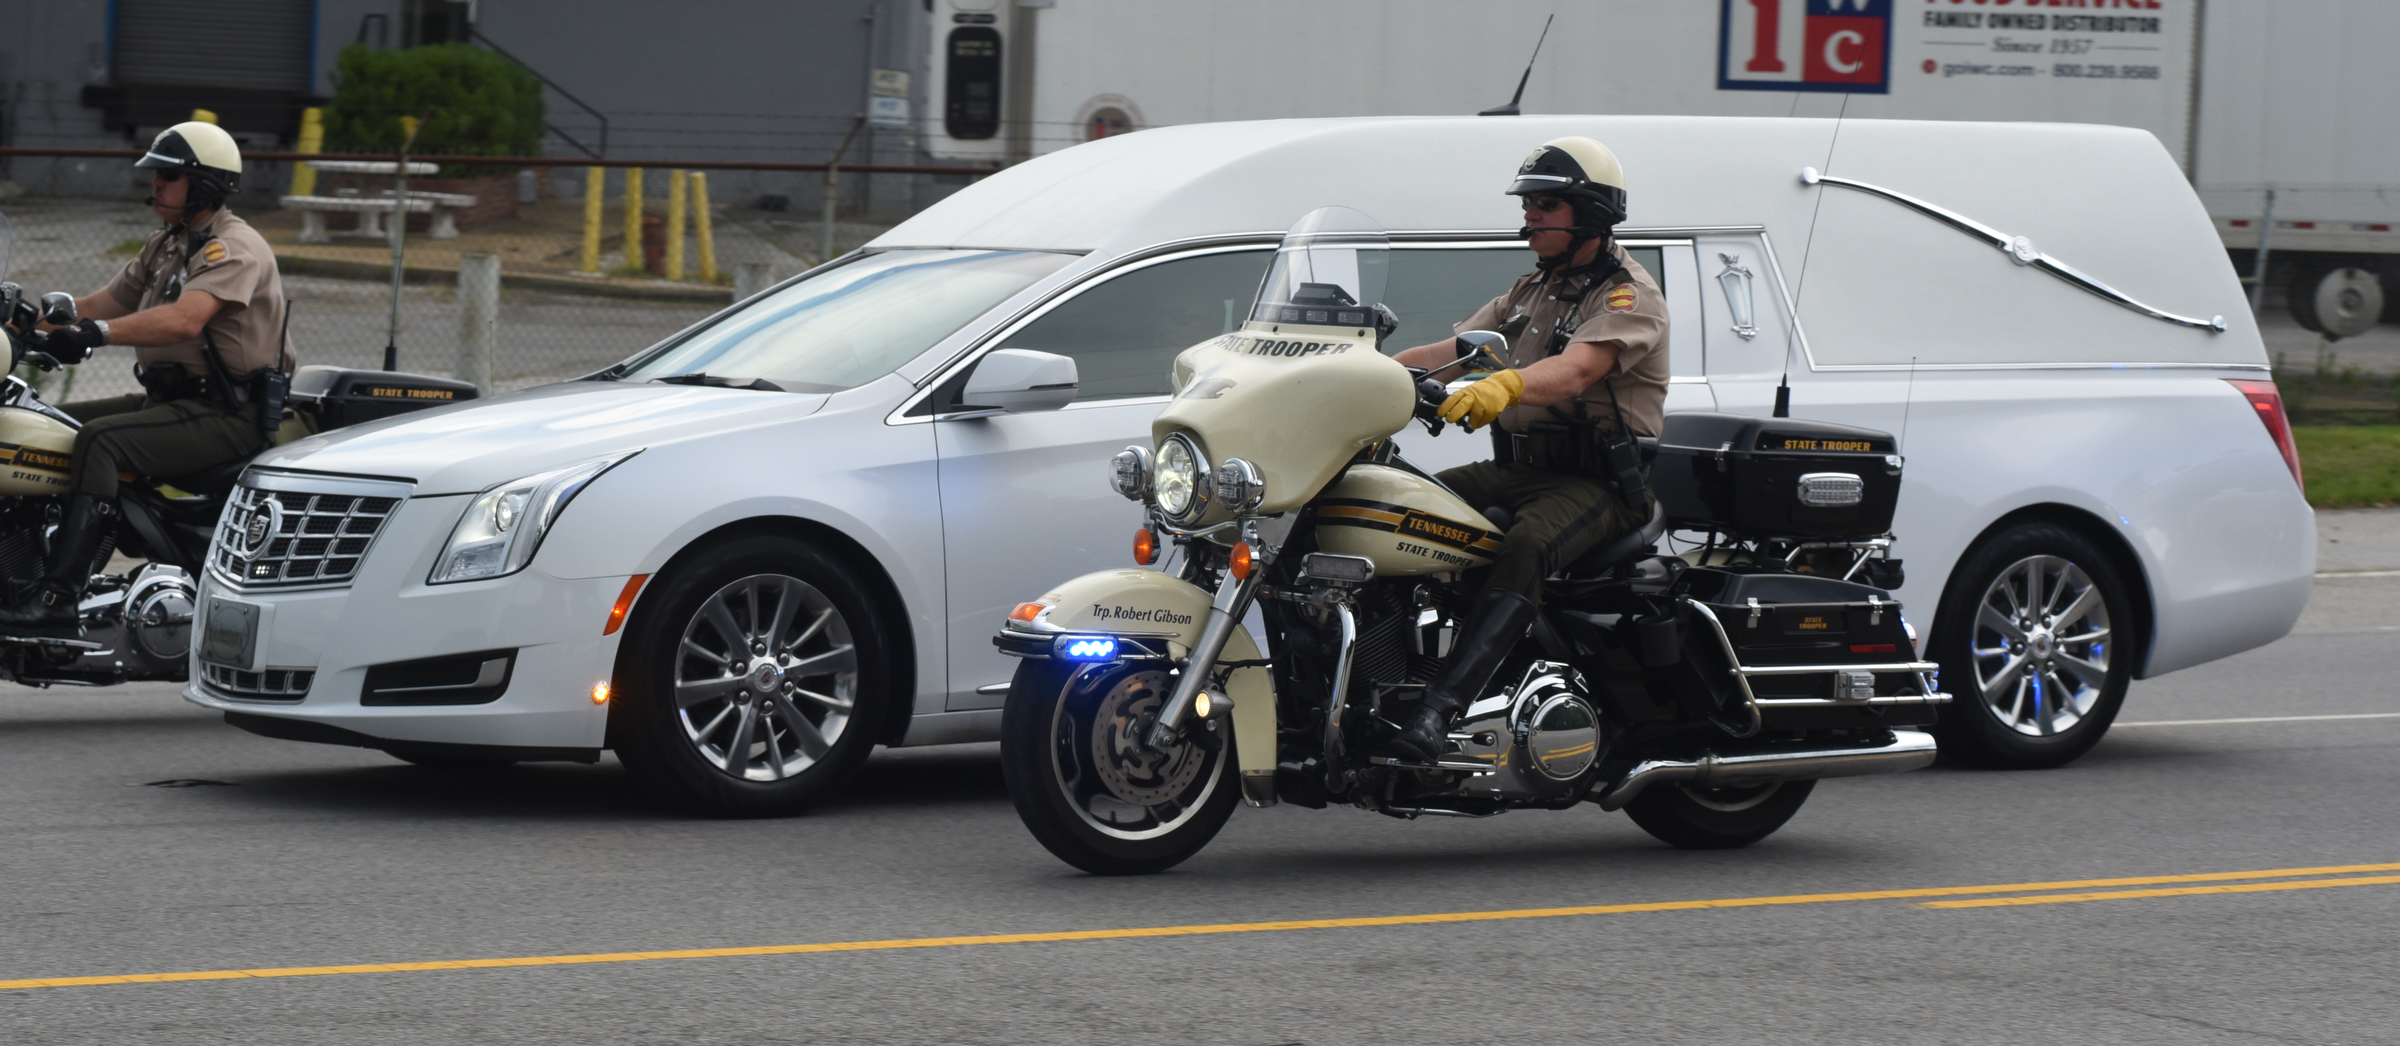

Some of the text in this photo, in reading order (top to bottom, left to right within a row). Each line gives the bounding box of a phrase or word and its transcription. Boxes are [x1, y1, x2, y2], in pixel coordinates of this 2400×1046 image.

[1923, 11, 2161, 33] FAMILY OWNED DISTRIBUTOR
[1823, 29, 1865, 74] C
[1992, 36, 2094, 54] Since 1957
[1214, 334, 1354, 358] STATE TROOPER
[372, 387, 454, 400] STATE TROOPER
[1784, 439, 1872, 452] STATE TROOPER
[12, 470, 43, 483] STATE
[1408, 517, 1472, 543] TENNESSEE
[1396, 541, 1475, 568] STATE TROOPER
[1092, 604, 1193, 626] Trp. Robert Gibson
[1799, 622, 1828, 630] TROOPER
